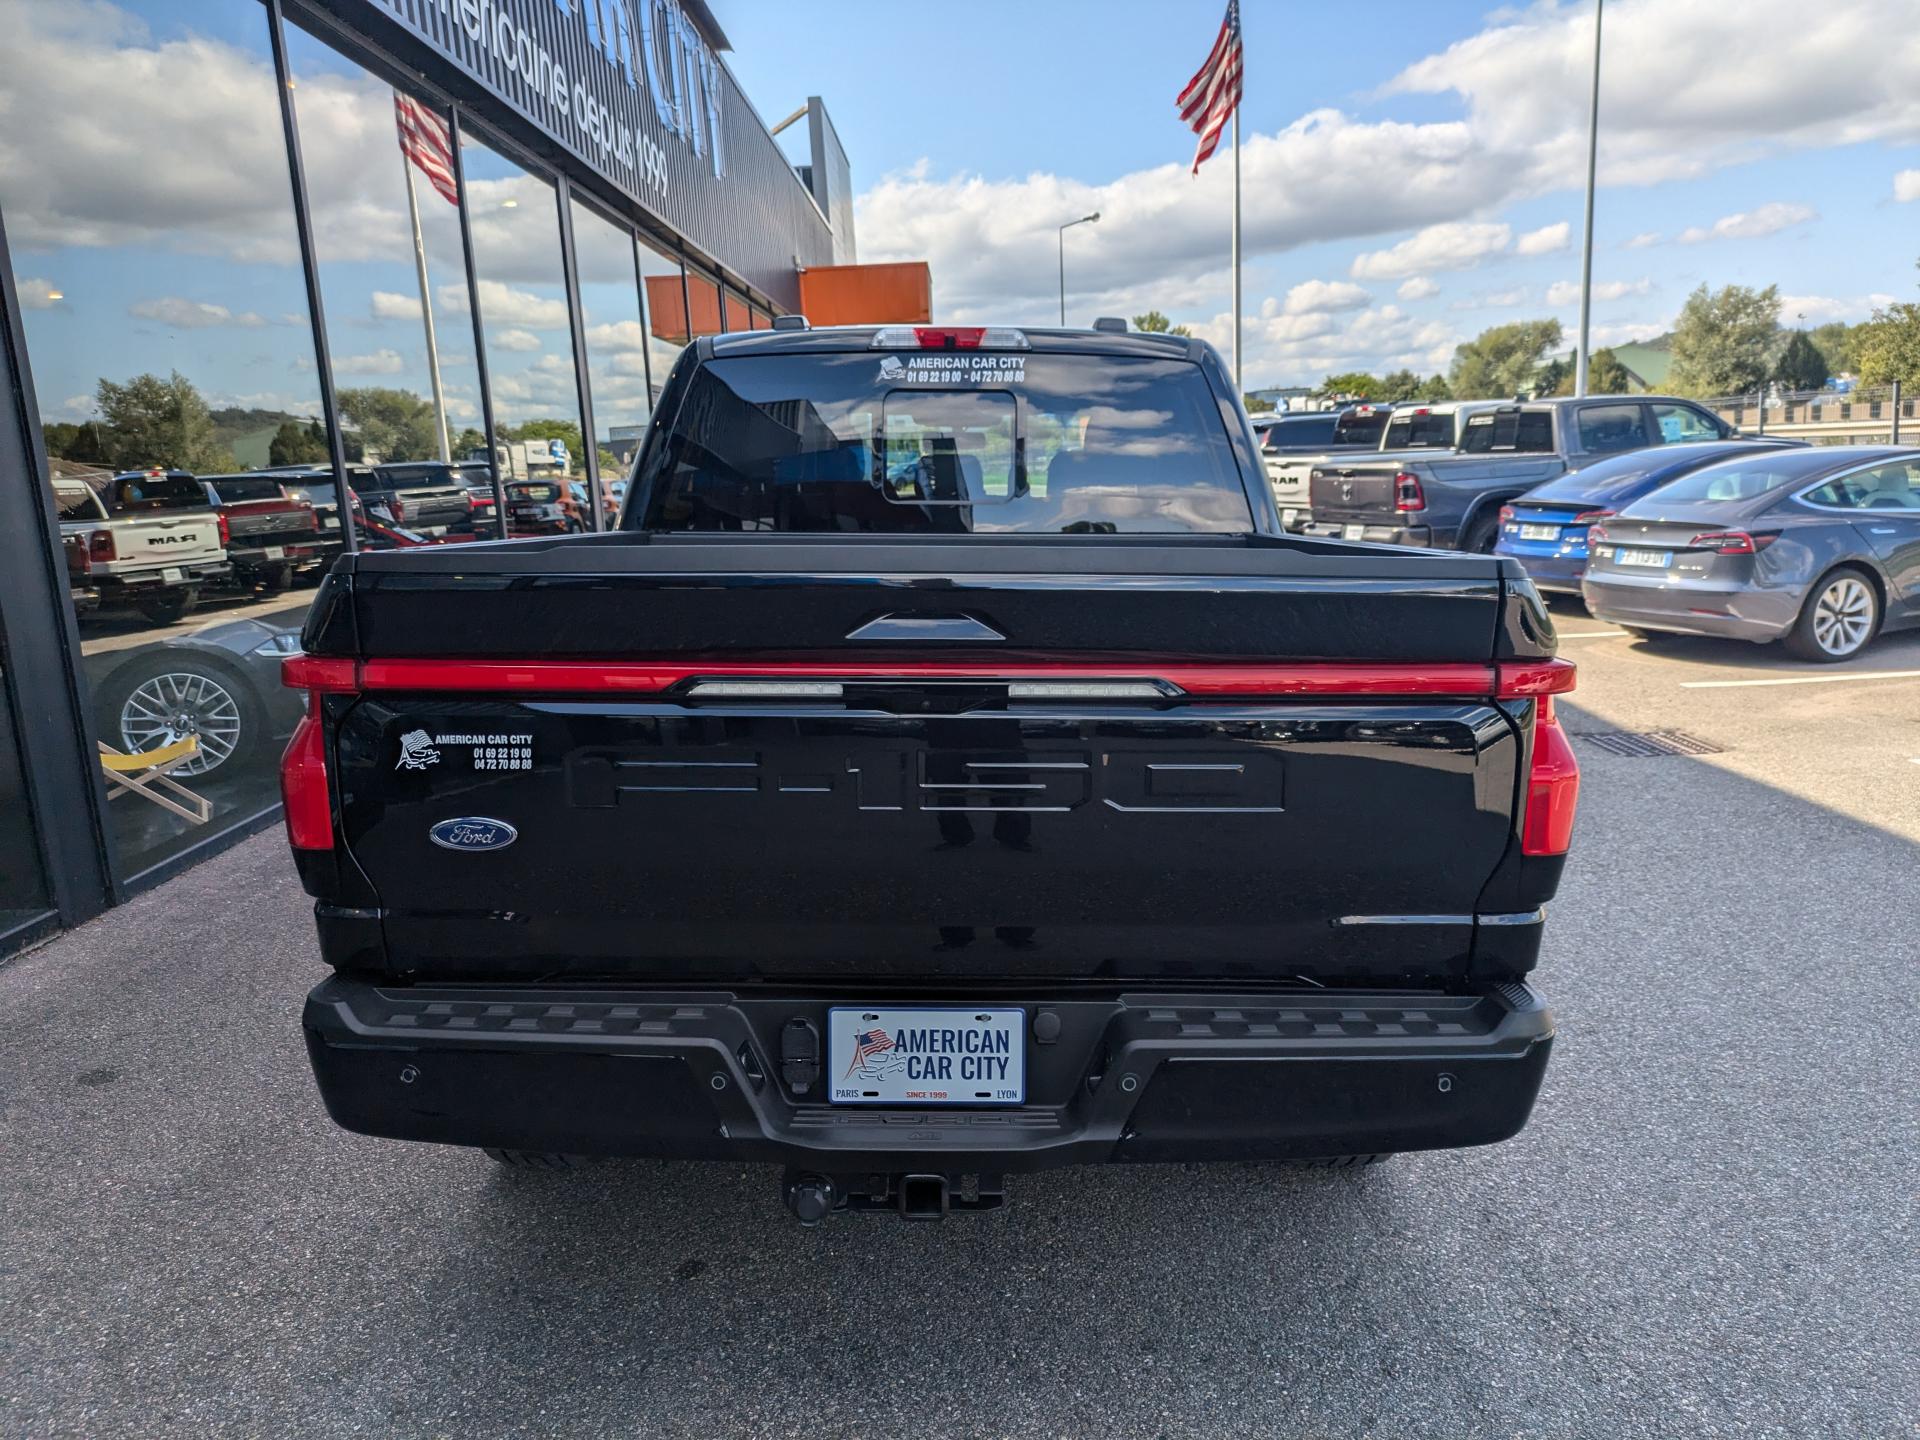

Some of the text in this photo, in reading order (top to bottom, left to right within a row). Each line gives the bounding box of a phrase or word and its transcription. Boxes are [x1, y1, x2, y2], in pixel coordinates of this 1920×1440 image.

[574, 75, 633, 171] depuis
[636, 128, 668, 197] 1999
[908, 357, 1026, 369] AMERICAN CAR CITY
[907, 371, 916, 383] 01
[918, 371, 929, 383] 69
[929, 371, 940, 383] 22
[941, 371, 951, 383] 19
[951, 371, 961, 383] 00
[970, 371, 981, 383] 04
[982, 371, 992, 383] 72
[993, 371, 1003, 383] 70
[435, 735, 533, 744] AMERICAN CAR CITY
[474, 748, 532, 758] 01 69 22 19 00
[474, 759, 532, 769] 04 72 70 88 88
[563, 750, 1285, 814] F-150
[449, 824, 496, 844] Ford
[894, 1028, 1010, 1053] AMERICAN
[907, 1055, 1010, 1080] CAR CITY
[836, 1089, 859, 1098] PARIS
[906, 1091, 948, 1099] SINCE 1999
[997, 1090, 1018, 1099] LYON
